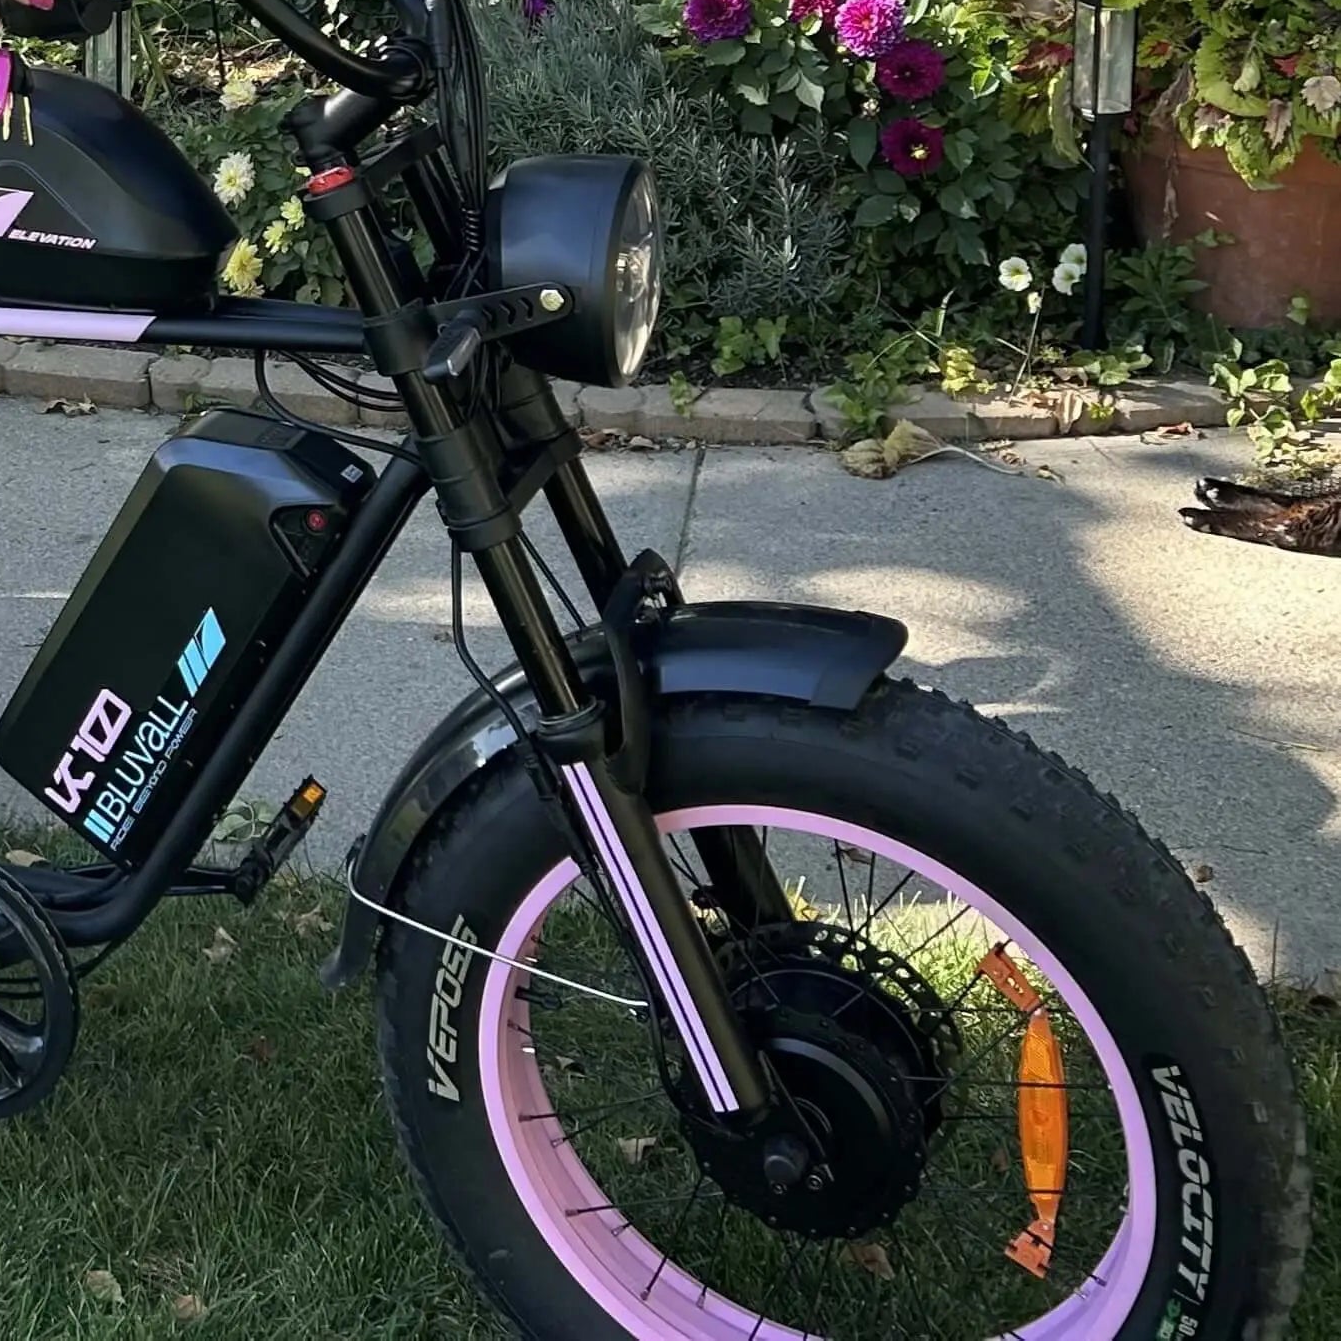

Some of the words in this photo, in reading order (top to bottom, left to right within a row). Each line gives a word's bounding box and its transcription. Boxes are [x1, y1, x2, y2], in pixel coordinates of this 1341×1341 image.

[8, 229, 97, 250] ELEVATION
[164, 707, 199, 760] POWER
[1151, 1064, 1214, 1302] VELOCITY
